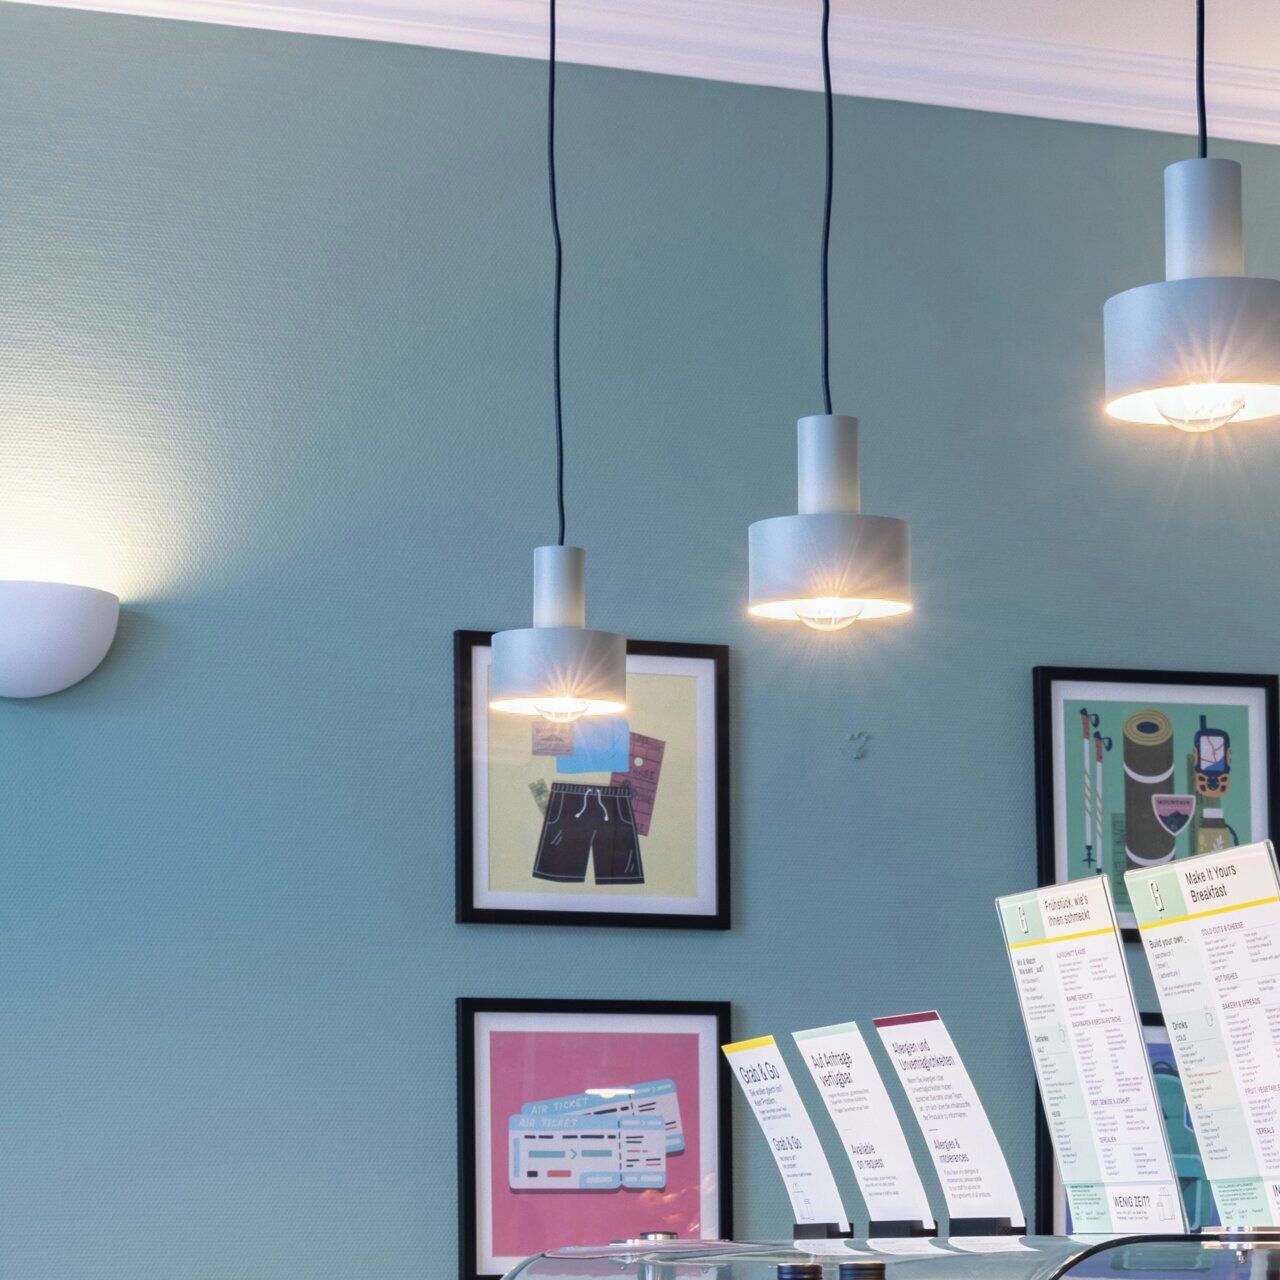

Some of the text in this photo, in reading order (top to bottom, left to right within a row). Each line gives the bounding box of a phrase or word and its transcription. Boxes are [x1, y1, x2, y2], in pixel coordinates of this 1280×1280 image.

[1185, 864, 1237, 885] Make It Yours
[1190, 884, 1228, 903] Breakfast
[1064, 910, 1091, 925] schmeckt
[1148, 939, 1162, 950] Build
[1162, 938, 1173, 948] your
[1172, 1020, 1188, 1031] Drinks
[892, 1038, 931, 1056] Allergien und
[811, 1051, 852, 1069] Auf Anfrage
[740, 1061, 780, 1084] Grab & Go
[820, 1070, 853, 1088] verfügbar
[531, 1097, 589, 1114] AIR TICKET
[519, 1118, 577, 1127] AIR TICKET
[1256, 1127, 1275, 1135] CEREALS
[772, 1137, 788, 1151] Grab
[791, 1135, 802, 1150] Go
[851, 1141, 876, 1155] Available
[933, 1140, 956, 1151] Allergies
[857, 1158, 885, 1170] on request
[1112, 1195, 1151, 1208] WENIG ZEIT?
